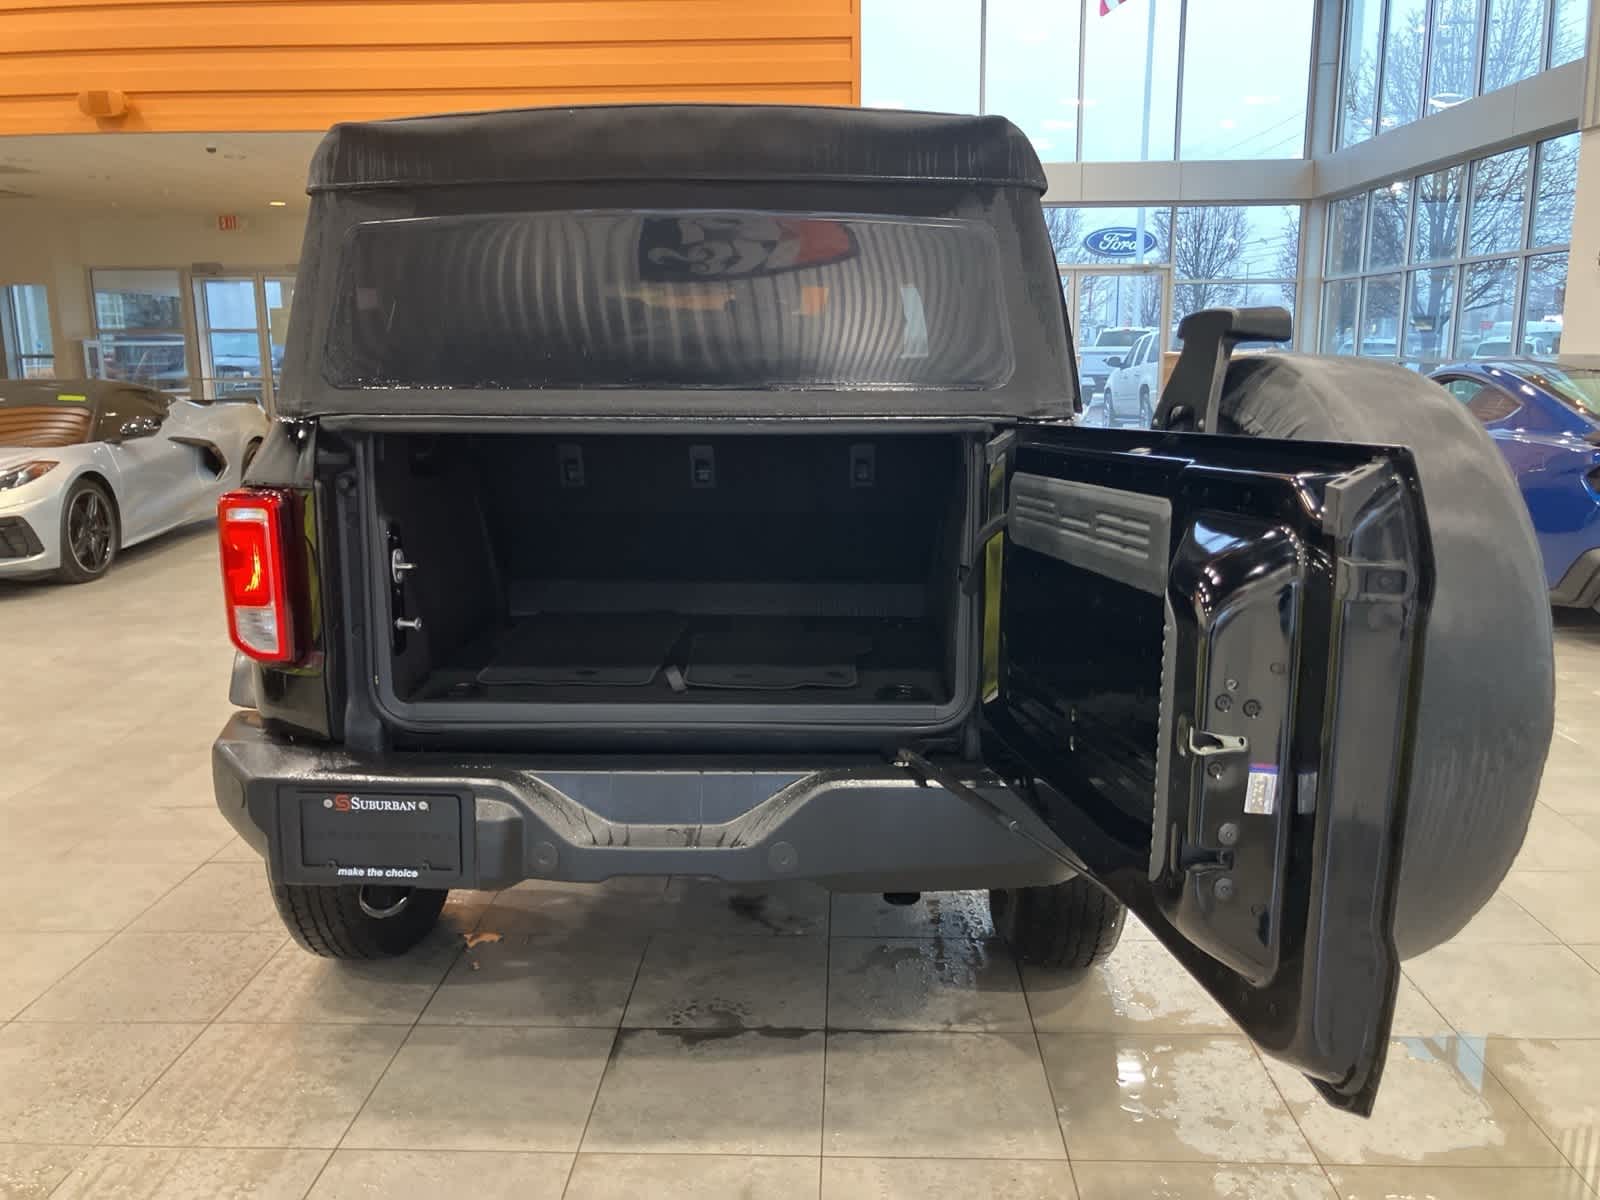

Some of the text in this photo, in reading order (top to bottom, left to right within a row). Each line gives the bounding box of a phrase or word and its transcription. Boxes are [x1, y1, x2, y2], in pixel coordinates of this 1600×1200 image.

[337, 867, 419, 878] make the choice
